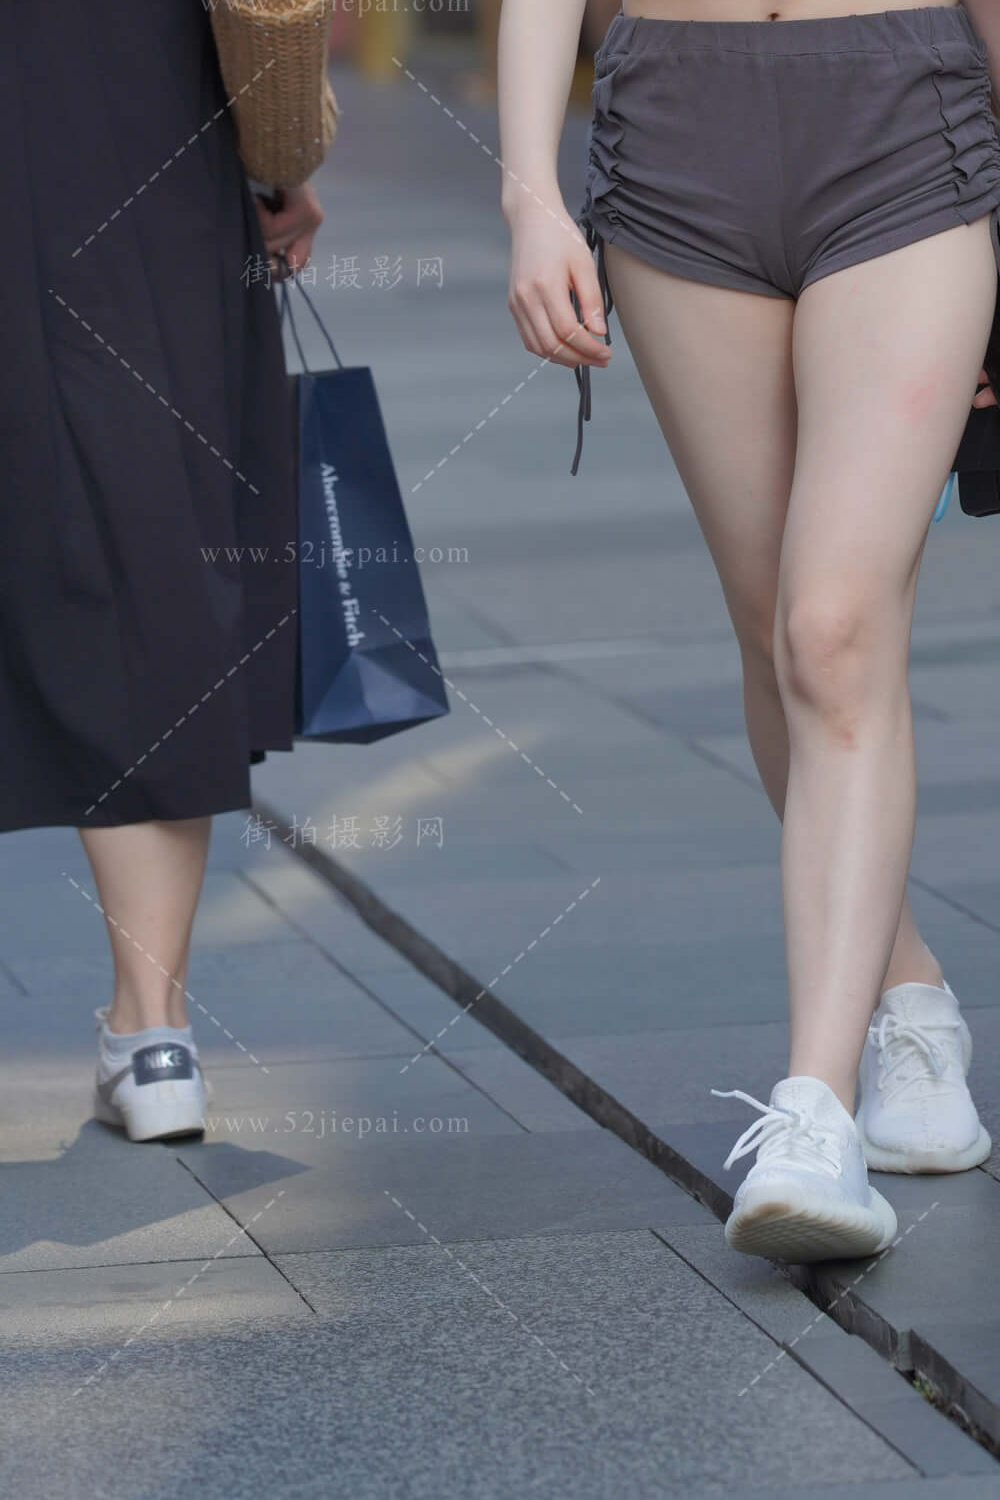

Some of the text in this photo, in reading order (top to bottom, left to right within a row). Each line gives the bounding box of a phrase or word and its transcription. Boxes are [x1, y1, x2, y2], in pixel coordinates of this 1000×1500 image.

[320, 463, 350, 579] Abercrombie
[342, 598, 365, 647] Fitch
[144, 1050, 182, 1068] NIKE
